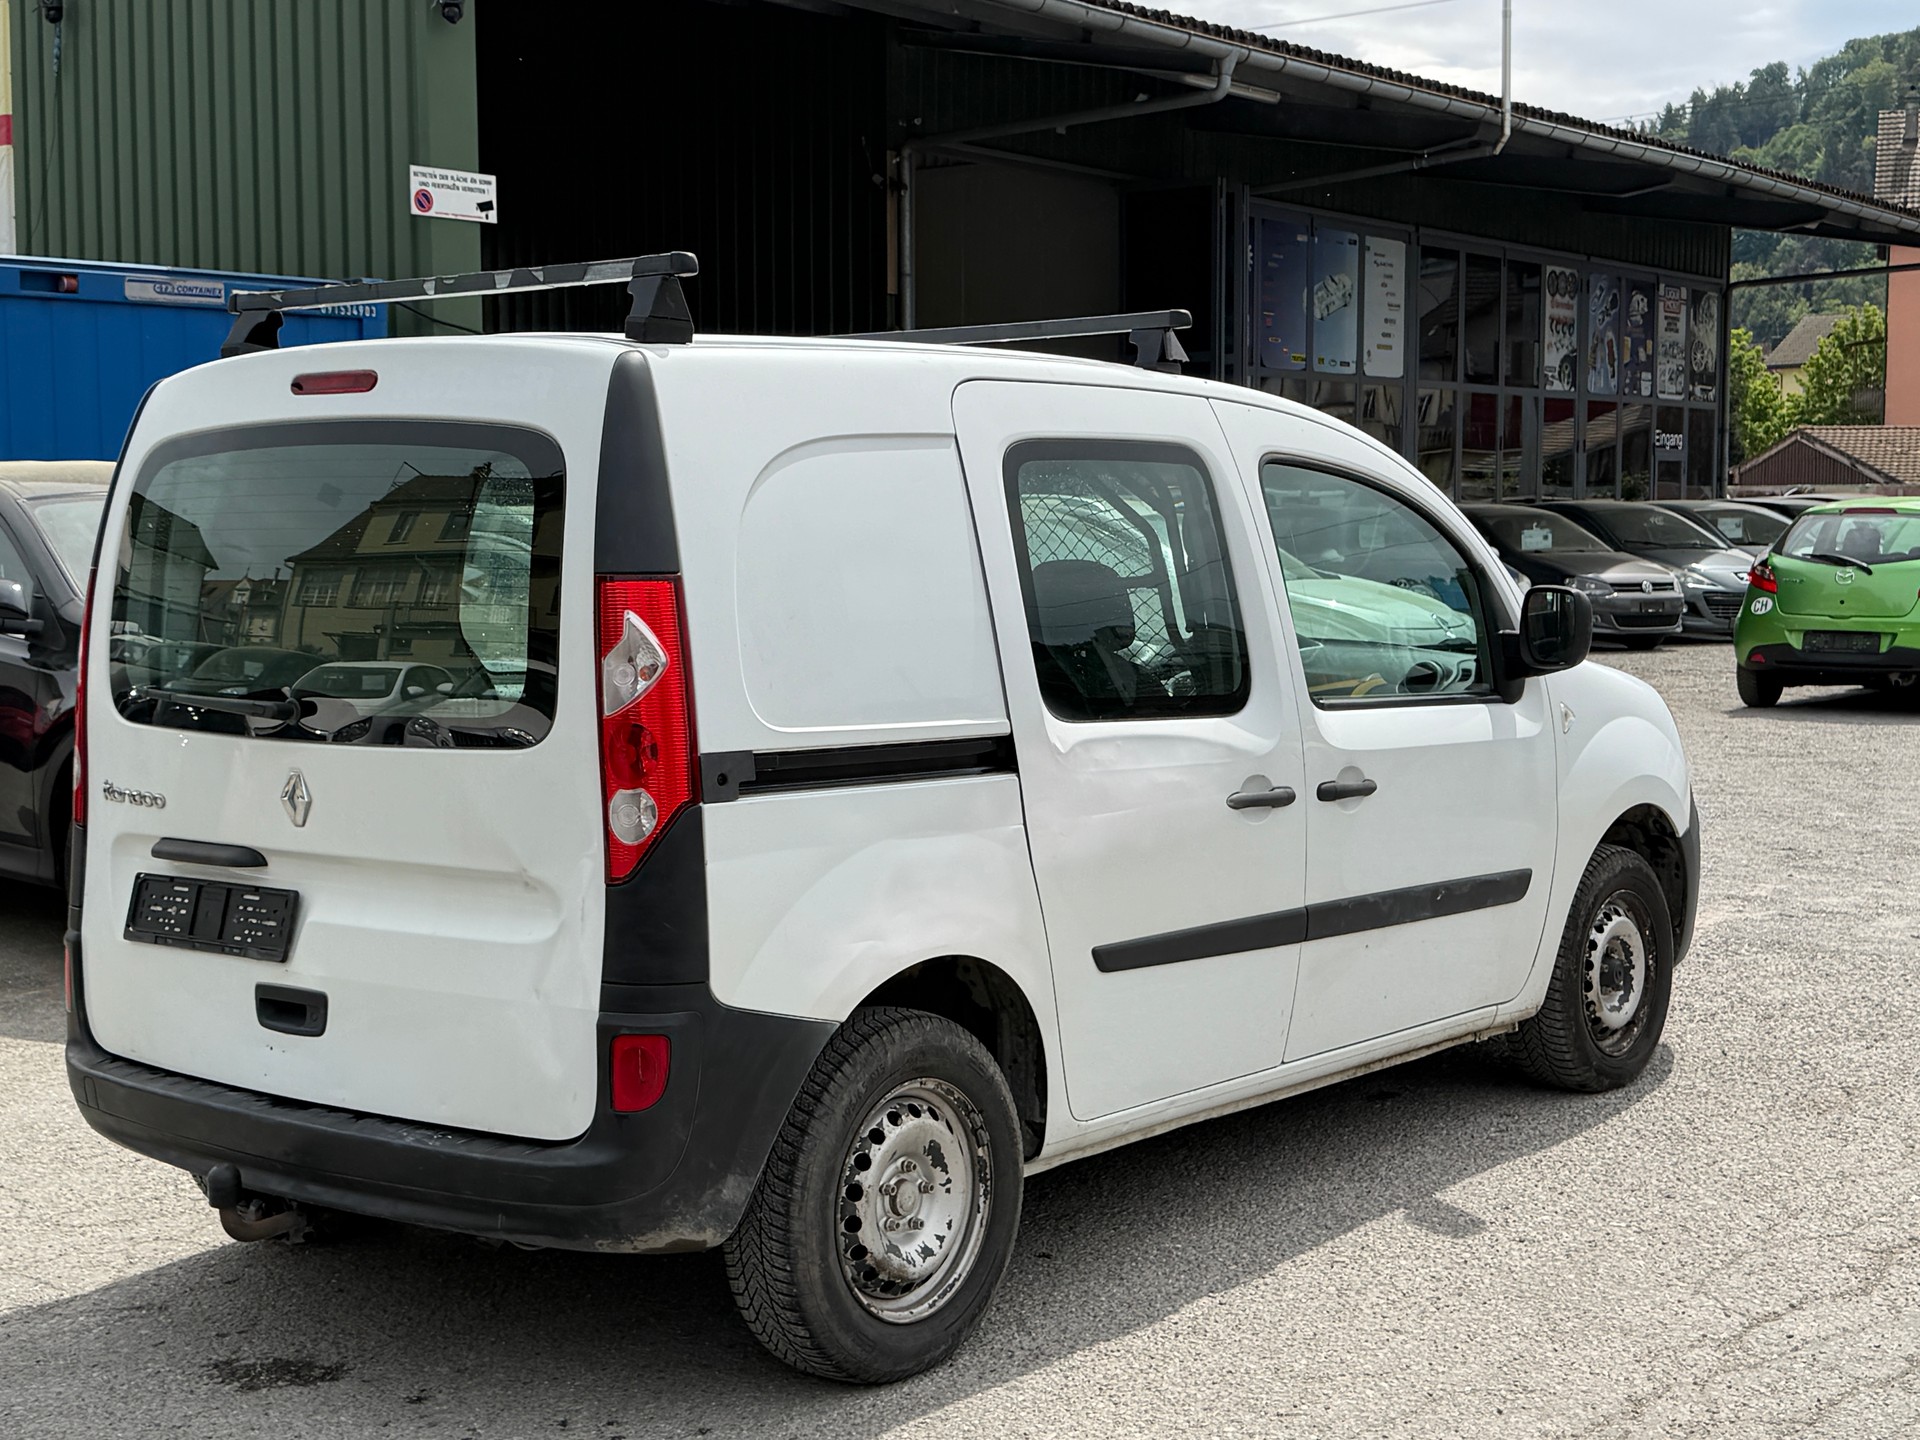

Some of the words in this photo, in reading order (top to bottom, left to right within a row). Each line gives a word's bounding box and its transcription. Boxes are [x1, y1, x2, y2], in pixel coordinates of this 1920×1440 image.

[176, 285, 223, 297] CONTAINEX
[1654, 429, 1684, 451] Eingang
[1753, 599, 1769, 613] CH
